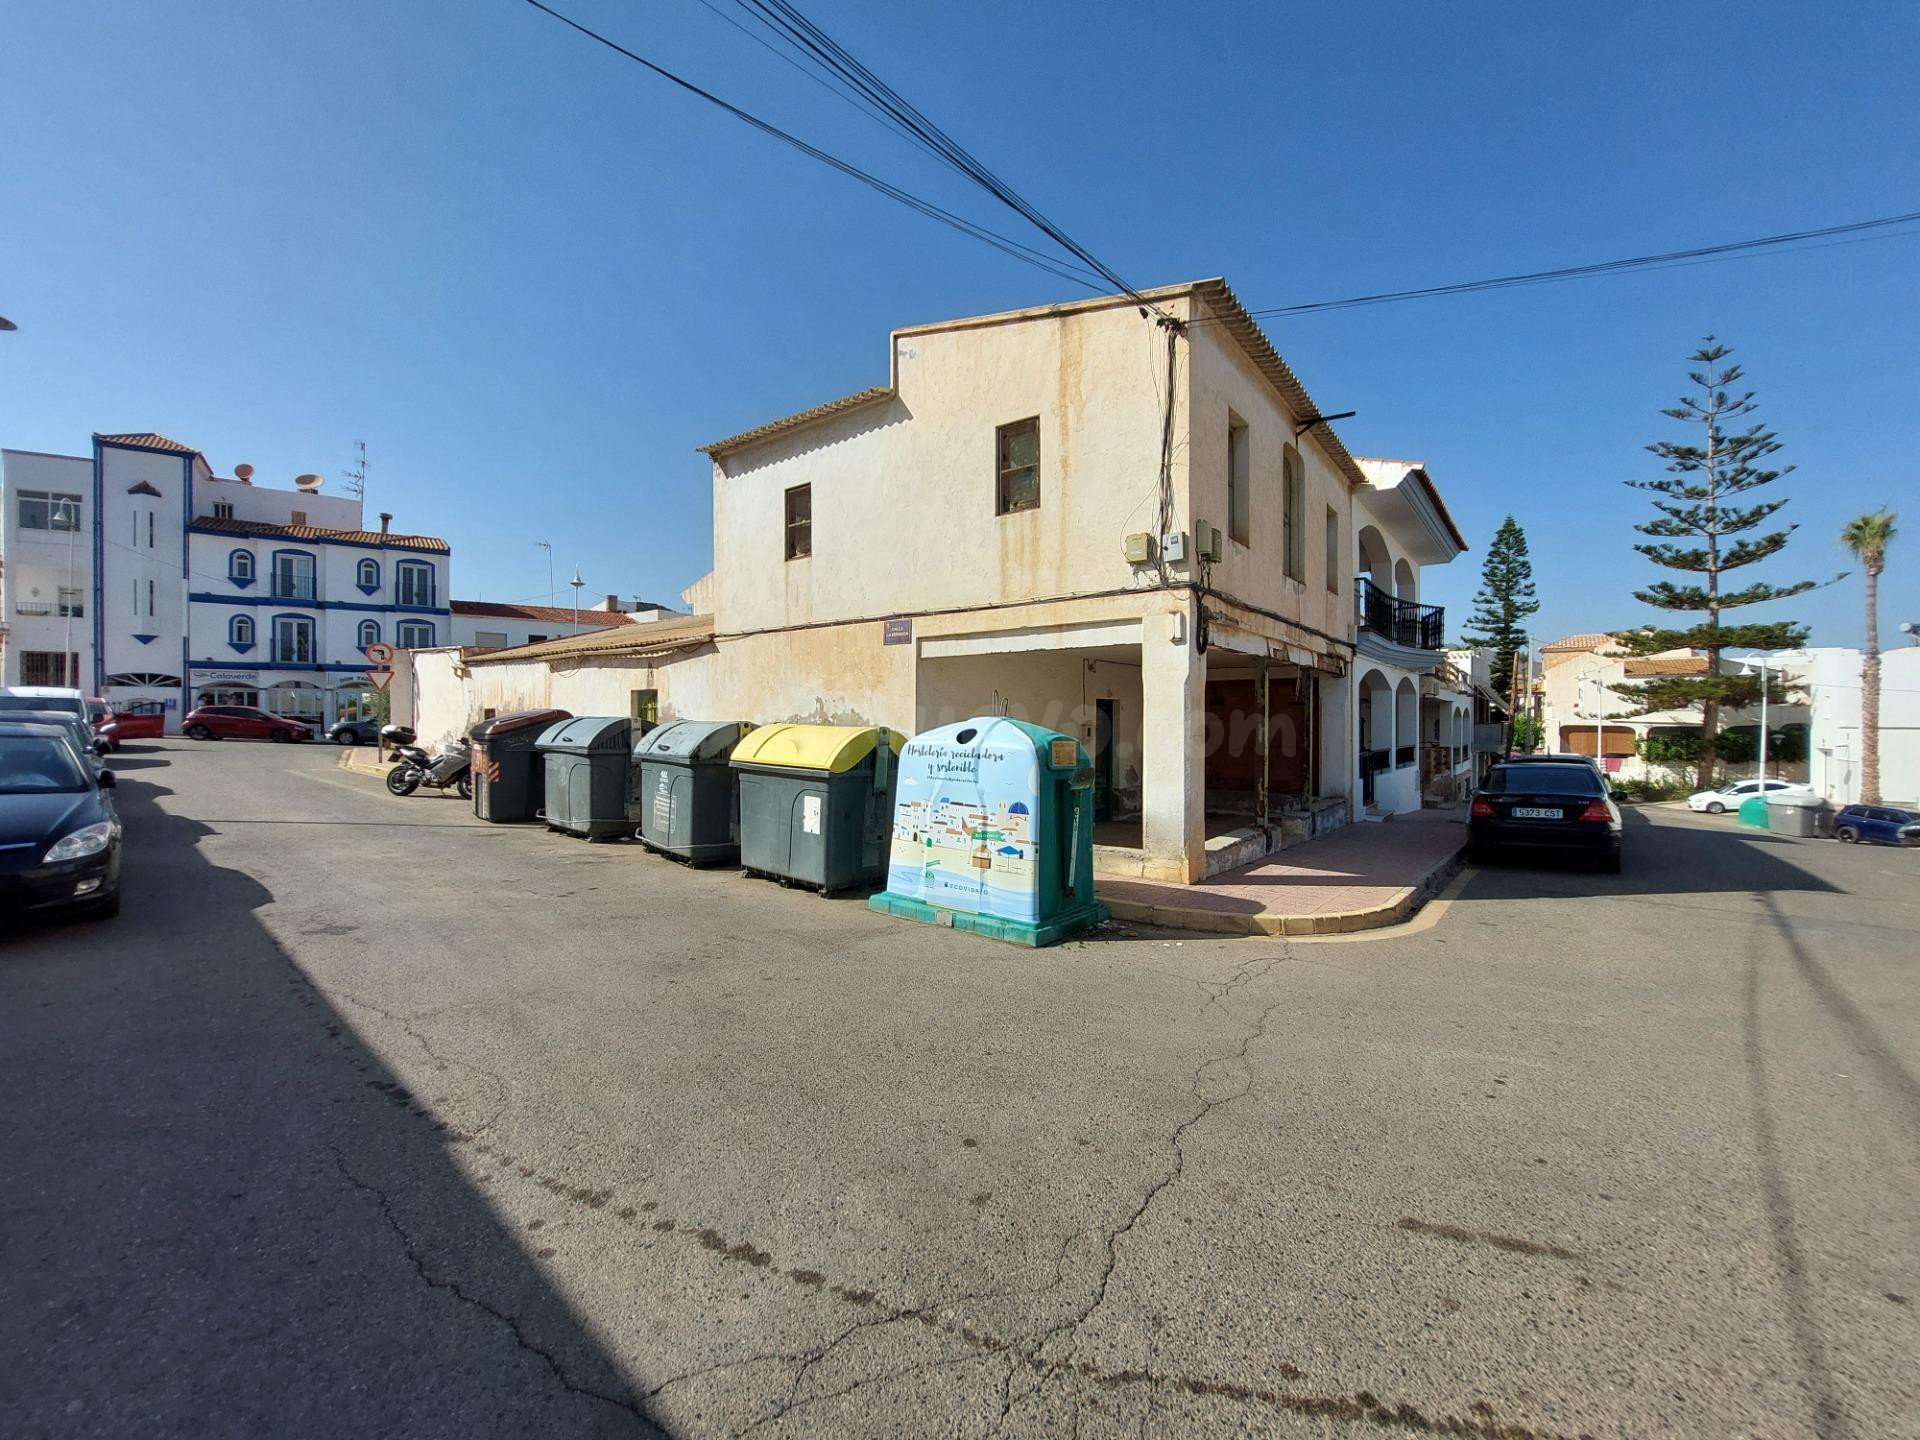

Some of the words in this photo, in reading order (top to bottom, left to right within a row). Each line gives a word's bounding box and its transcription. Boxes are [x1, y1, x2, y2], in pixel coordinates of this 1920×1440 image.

[210, 672, 257, 680] Calaverde
[950, 748, 1005, 762] recicladora
[936, 761, 978, 773] sostenible
[1519, 809, 1541, 817] 5373
[1544, 810, 1561, 818] CST
